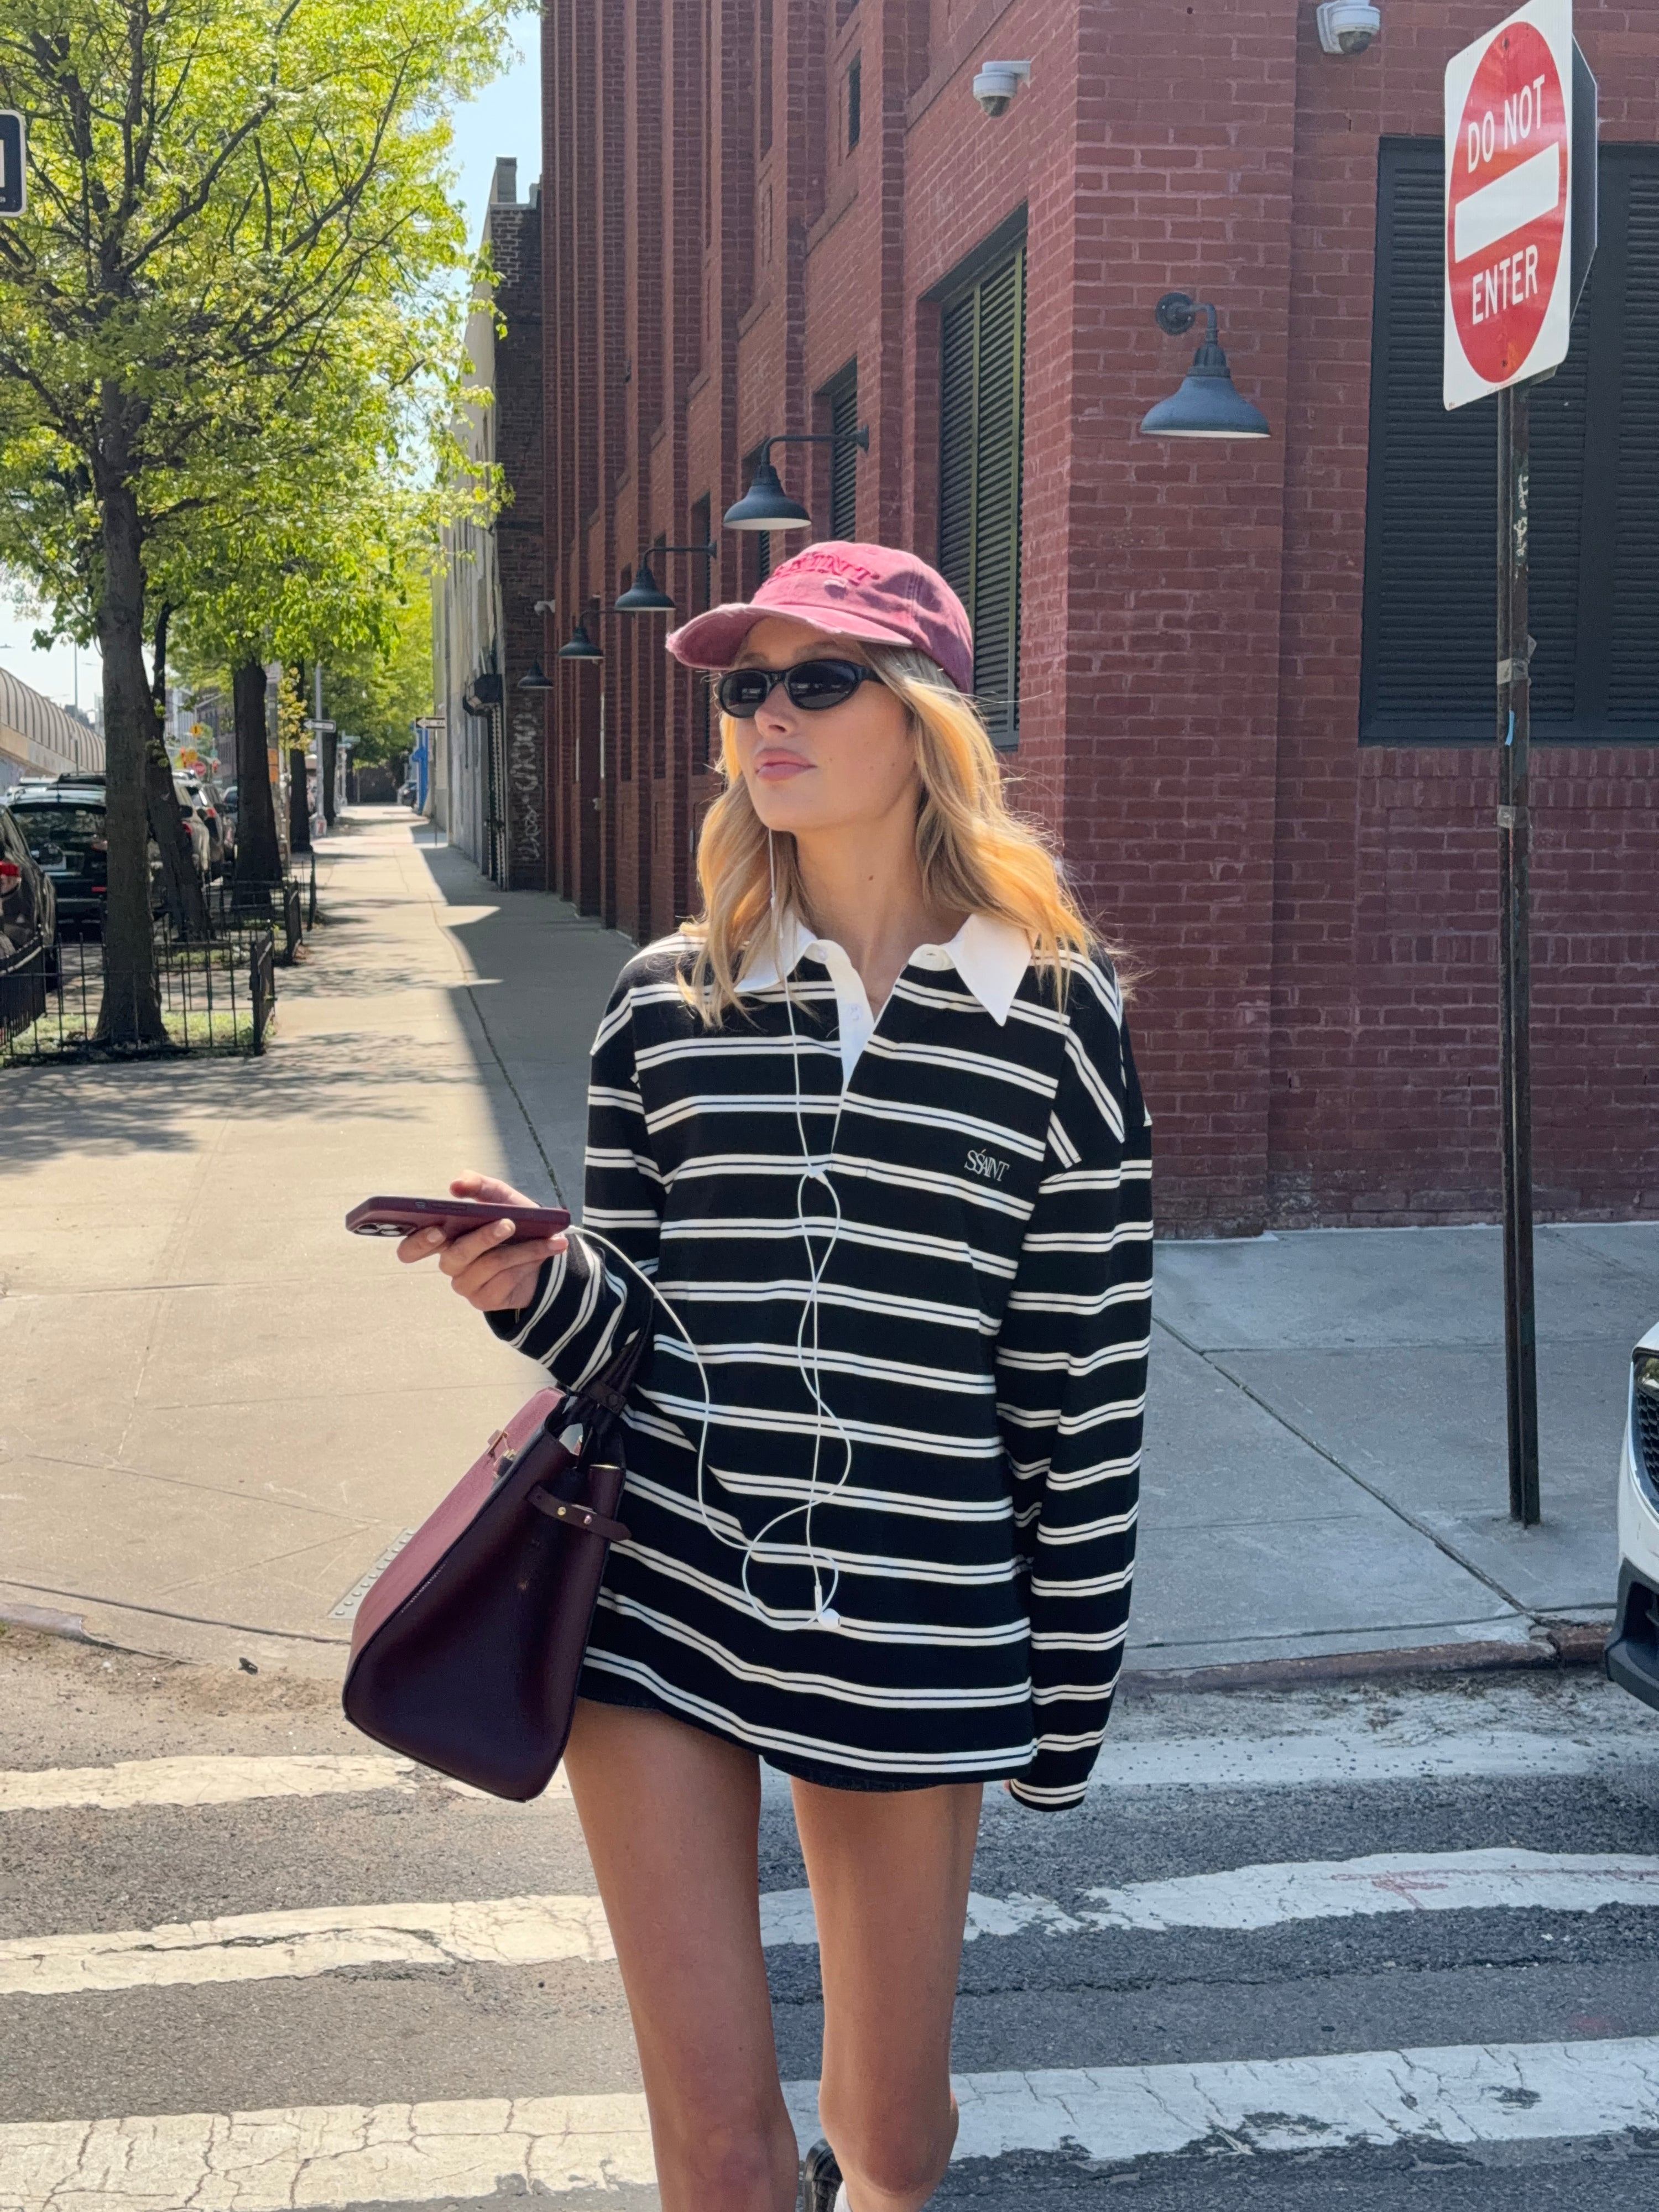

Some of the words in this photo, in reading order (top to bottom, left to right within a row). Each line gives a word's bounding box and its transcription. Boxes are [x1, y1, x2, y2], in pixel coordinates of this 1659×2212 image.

[1468, 111, 1494, 174] DO
[1504, 74, 1545, 150] NOT
[1473, 244, 1538, 325] ENTER
